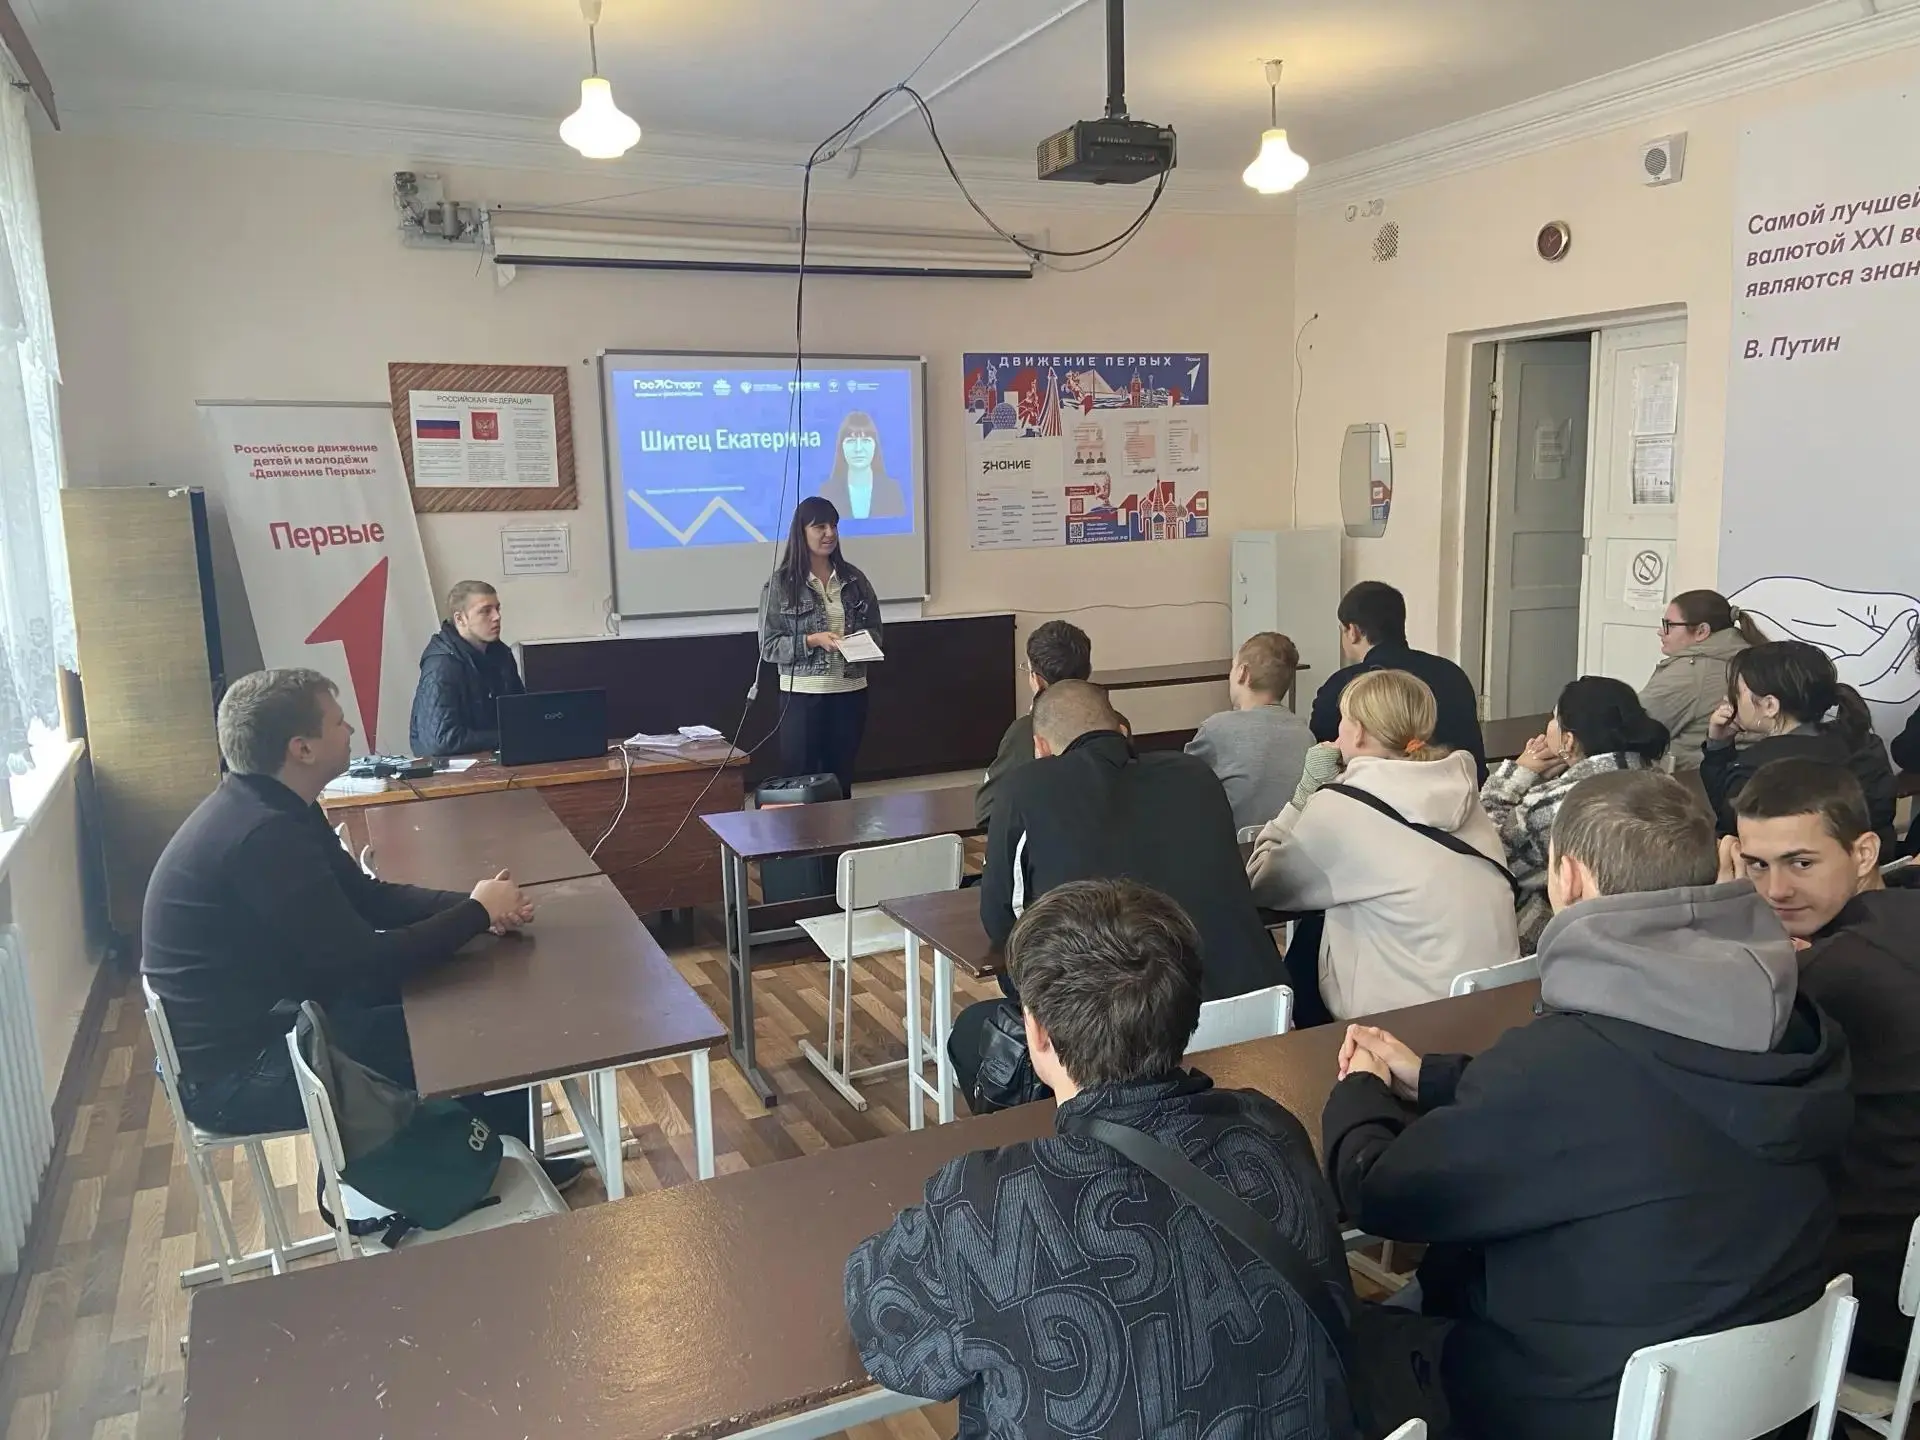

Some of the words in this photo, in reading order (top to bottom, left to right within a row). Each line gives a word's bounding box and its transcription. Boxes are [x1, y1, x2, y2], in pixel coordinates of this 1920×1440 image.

[1748, 203, 1825, 235] Самой
[1746, 232, 1845, 266] валютой
[1849, 224, 1895, 251] XXI
[1745, 269, 1854, 298] являются
[1744, 339, 1763, 359] В.
[1770, 335, 1840, 360] Путин
[998, 356, 1096, 368] ДВИЖЕНИЕ
[1105, 356, 1172, 367] ПЕРВЫХ
[436, 395, 488, 404] РОССИЙСКАЯ
[490, 397, 532, 405] ФЕДЕРАЦИЯ
[233, 444, 315, 454] Российское
[317, 444, 378, 452] движение
[640, 430, 711, 453] Шитец
[716, 428, 821, 452] Екатерина
[249, 469, 323, 480] «Движение
[325, 467, 376, 478] Первых»
[253, 459, 292, 467] детей
[305, 455, 368, 465] молодёжи
[269, 522, 385, 555] Первые
